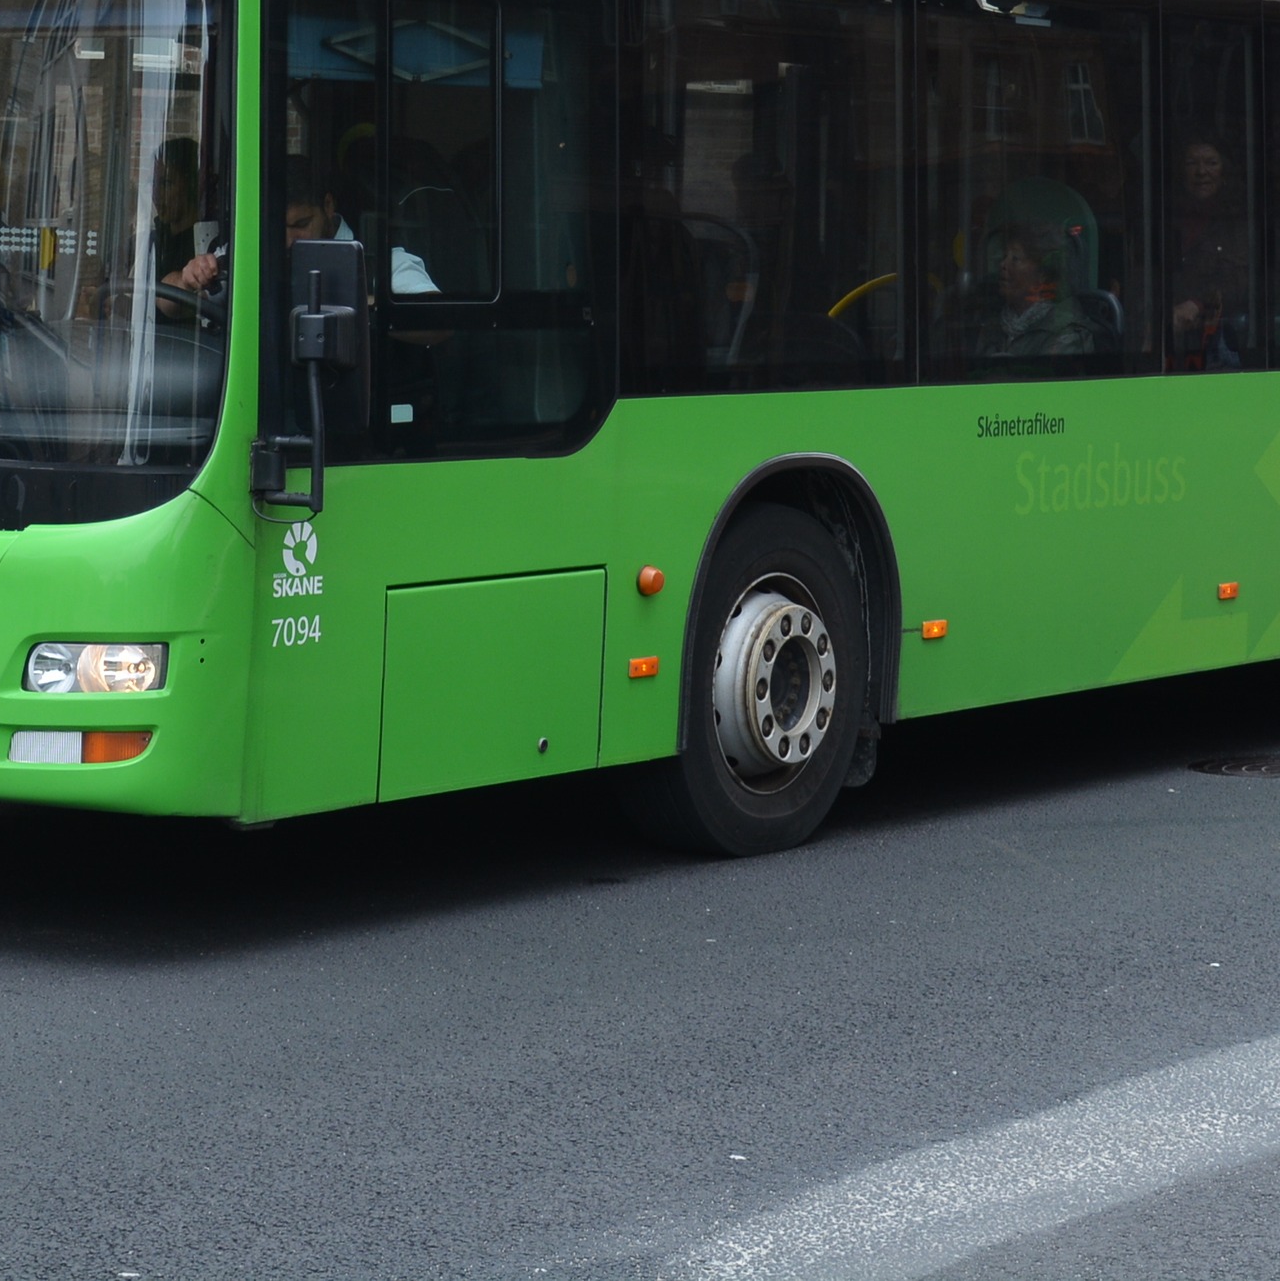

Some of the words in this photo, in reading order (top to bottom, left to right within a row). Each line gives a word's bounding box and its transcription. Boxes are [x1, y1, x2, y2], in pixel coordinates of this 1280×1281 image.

[977, 412, 1065, 438] Skånetrafiken
[1014, 442, 1187, 515] Stadsbuss
[272, 615, 321, 647] 7094
